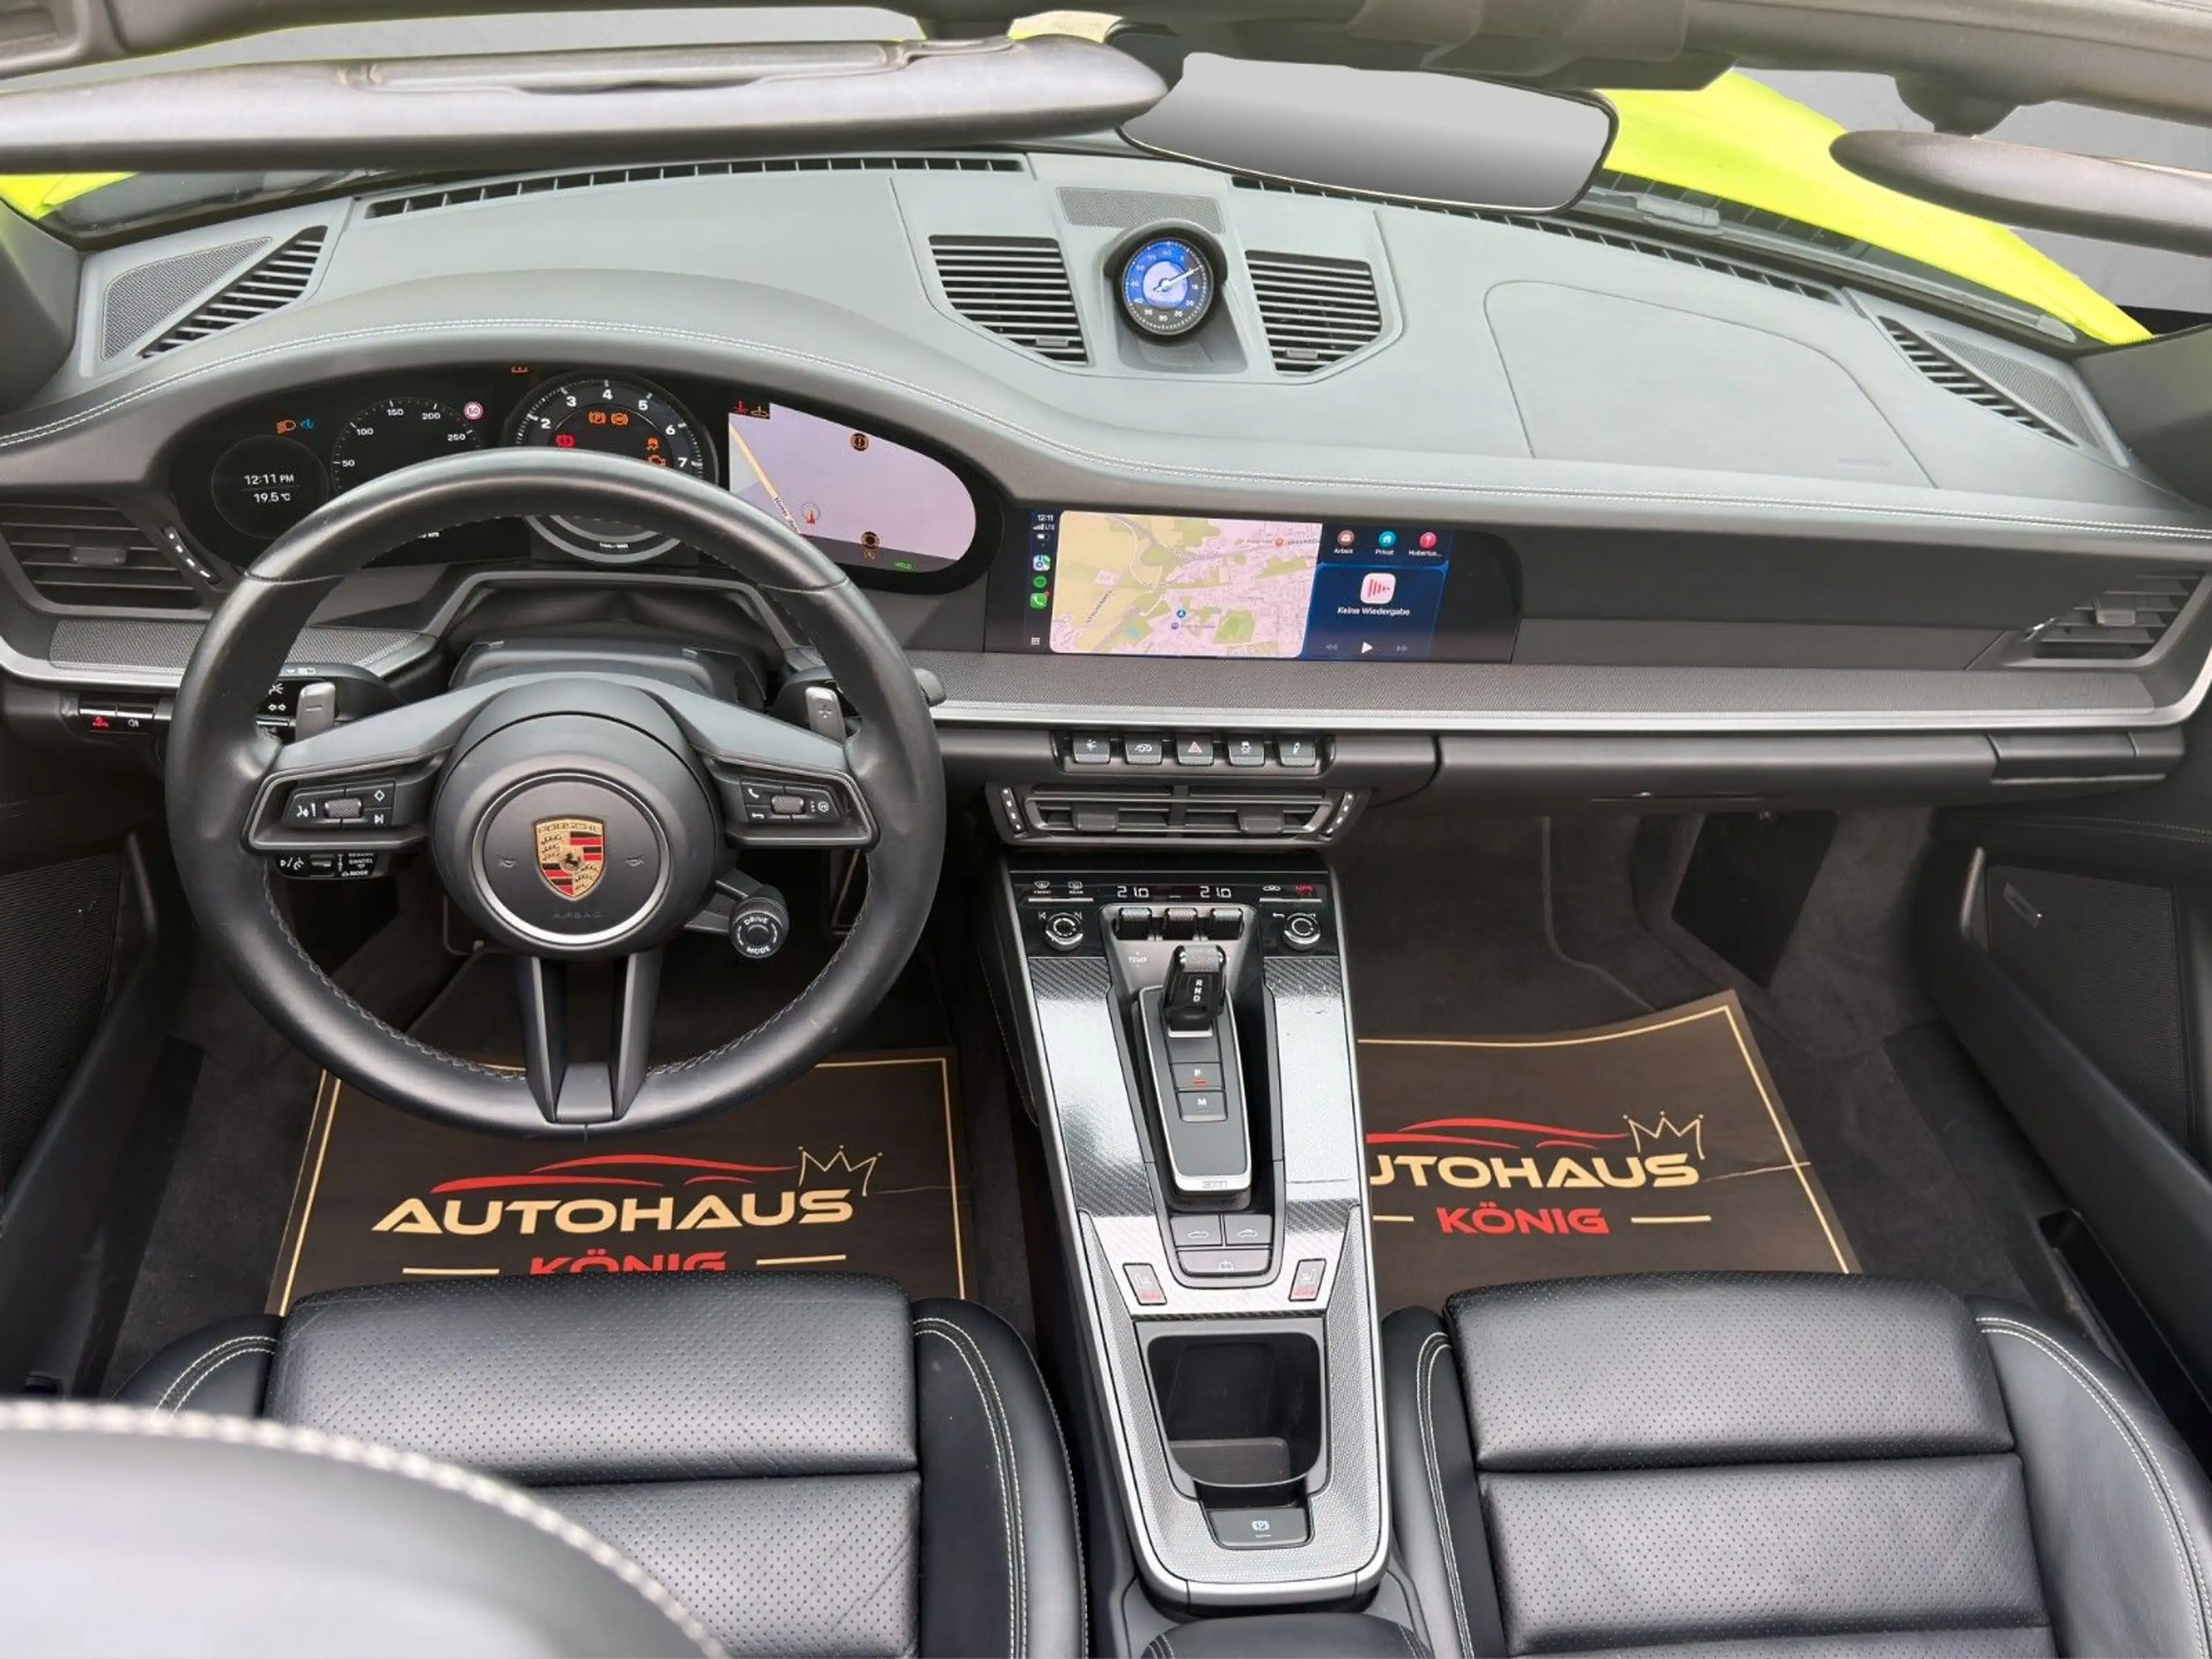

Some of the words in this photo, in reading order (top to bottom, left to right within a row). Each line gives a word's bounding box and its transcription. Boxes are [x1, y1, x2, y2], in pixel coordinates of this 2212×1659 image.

[603, 389, 613, 400] 4
[566, 396, 577, 407] 3
[638, 400, 648, 411] 5
[387, 408, 404, 416] 150
[422, 412, 441, 420] 200
[540, 419, 551, 429] 2
[356, 427, 374, 435] 100
[665, 425, 676, 435] 6
[447, 433, 465, 441] 250
[342, 459, 355, 467] 50
[677, 457, 688, 467] 7
[244, 474, 276, 484] 12:11
[279, 474, 294, 483] PM
[253, 492, 279, 503] 19.5
[1336, 606, 1359, 615] Keine
[1361, 607, 1411, 617] Wiedergabe
[744, 916, 768, 925] DRIVE
[747, 946, 771, 955] MODE
[1198, 1097, 1207, 1107] M
[371, 1188, 854, 1234] AUTOHAUS
[1436, 1201, 1610, 1234] KÖNIG
